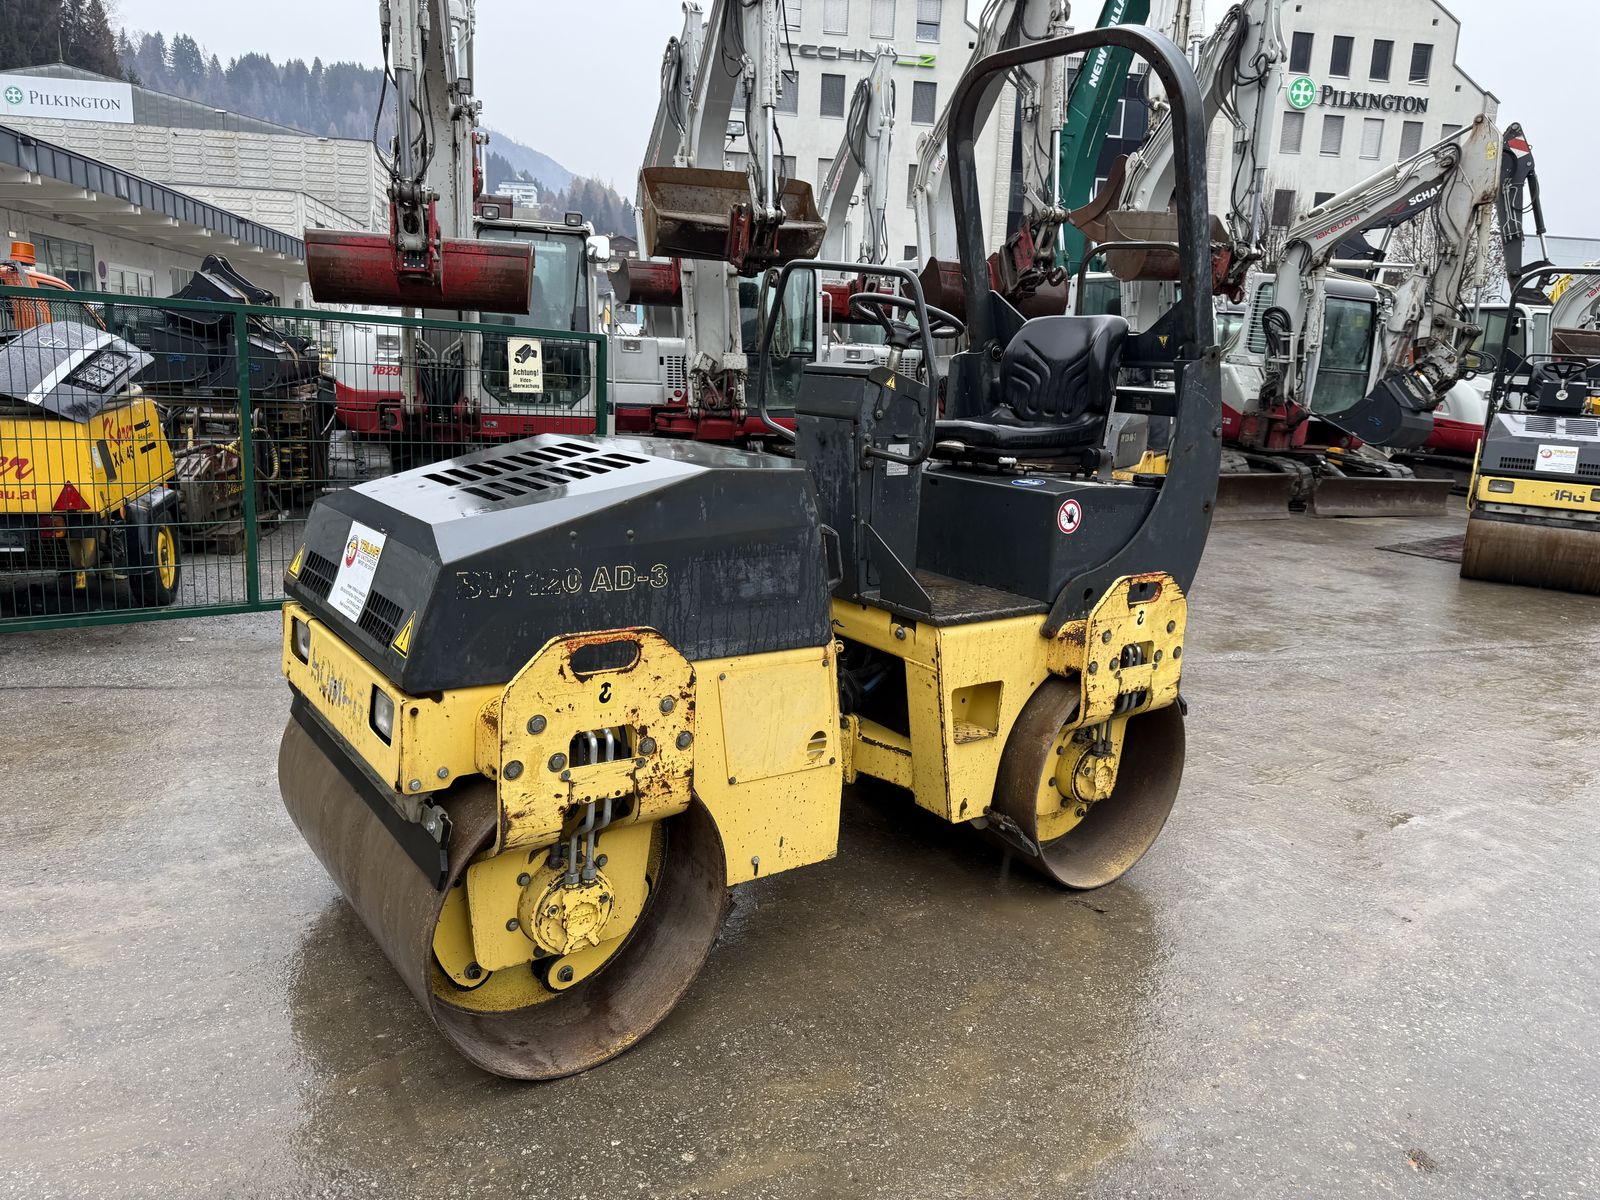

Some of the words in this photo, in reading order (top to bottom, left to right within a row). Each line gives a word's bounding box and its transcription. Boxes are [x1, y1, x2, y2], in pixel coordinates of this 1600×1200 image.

[1088, 47, 1108, 88] NEW
[29, 90, 121, 110] PILKINGTON
[1320, 84, 1430, 113] PILKINGTON
[512, 368, 540, 377] Achtung!
[589, 563, 669, 593] AD-3
